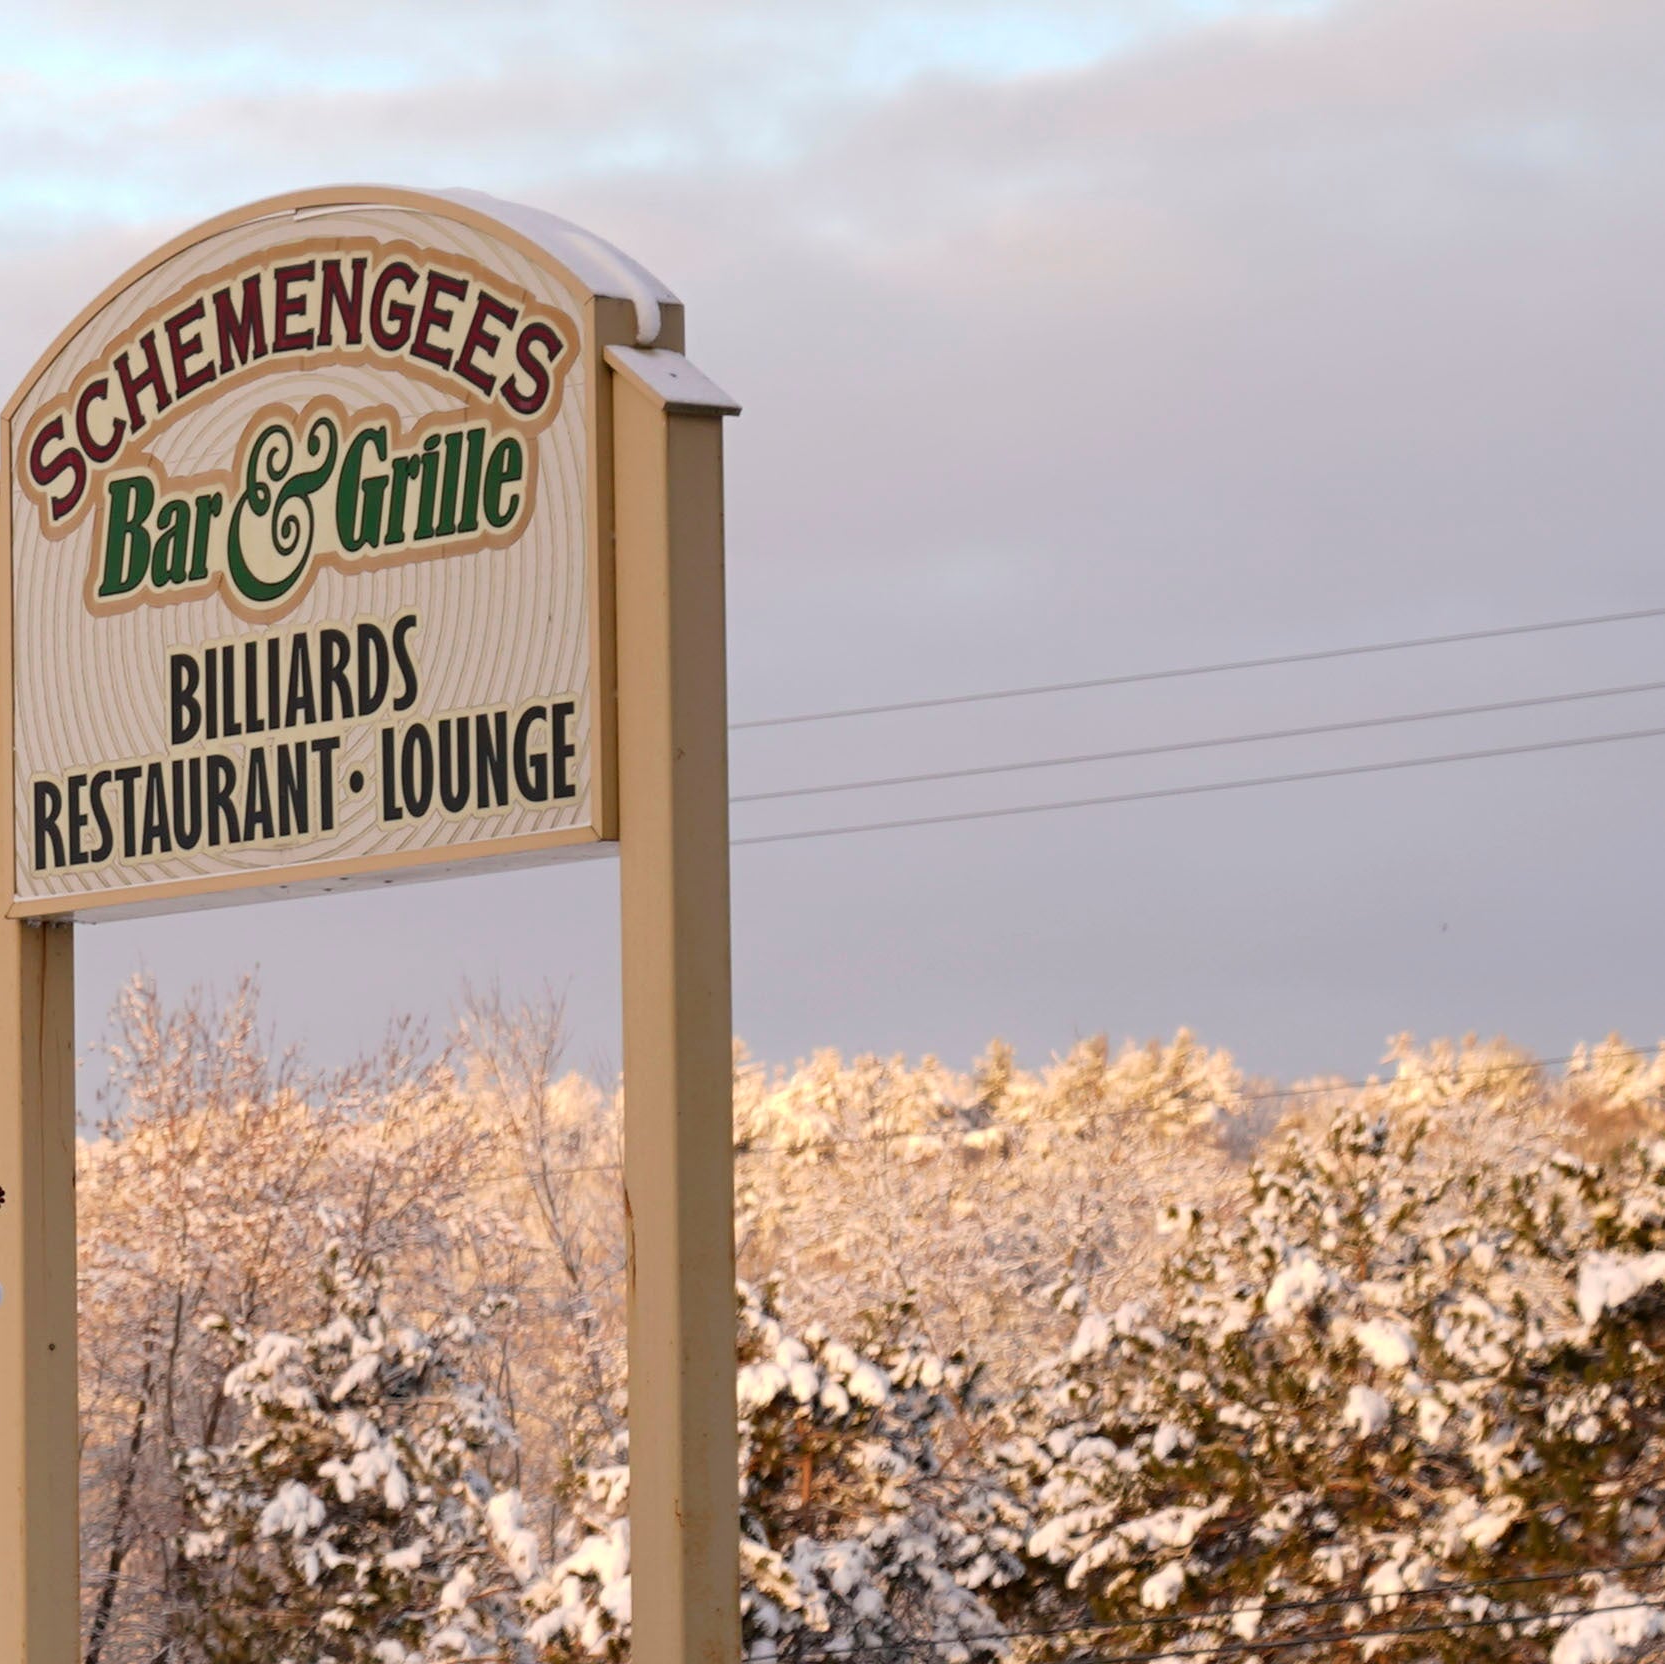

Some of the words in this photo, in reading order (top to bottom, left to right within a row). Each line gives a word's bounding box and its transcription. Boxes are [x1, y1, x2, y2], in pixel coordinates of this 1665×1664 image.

[28, 256, 565, 521] SCHEMENGEES
[98, 473, 225, 598] Bar
[227, 416, 337, 602] &
[336, 425, 525, 553] Grille
[170, 613, 418, 747] BILLIARDS
[34, 736, 342, 872] RESTAURANT
[381, 701, 576, 823] LOUNGE
